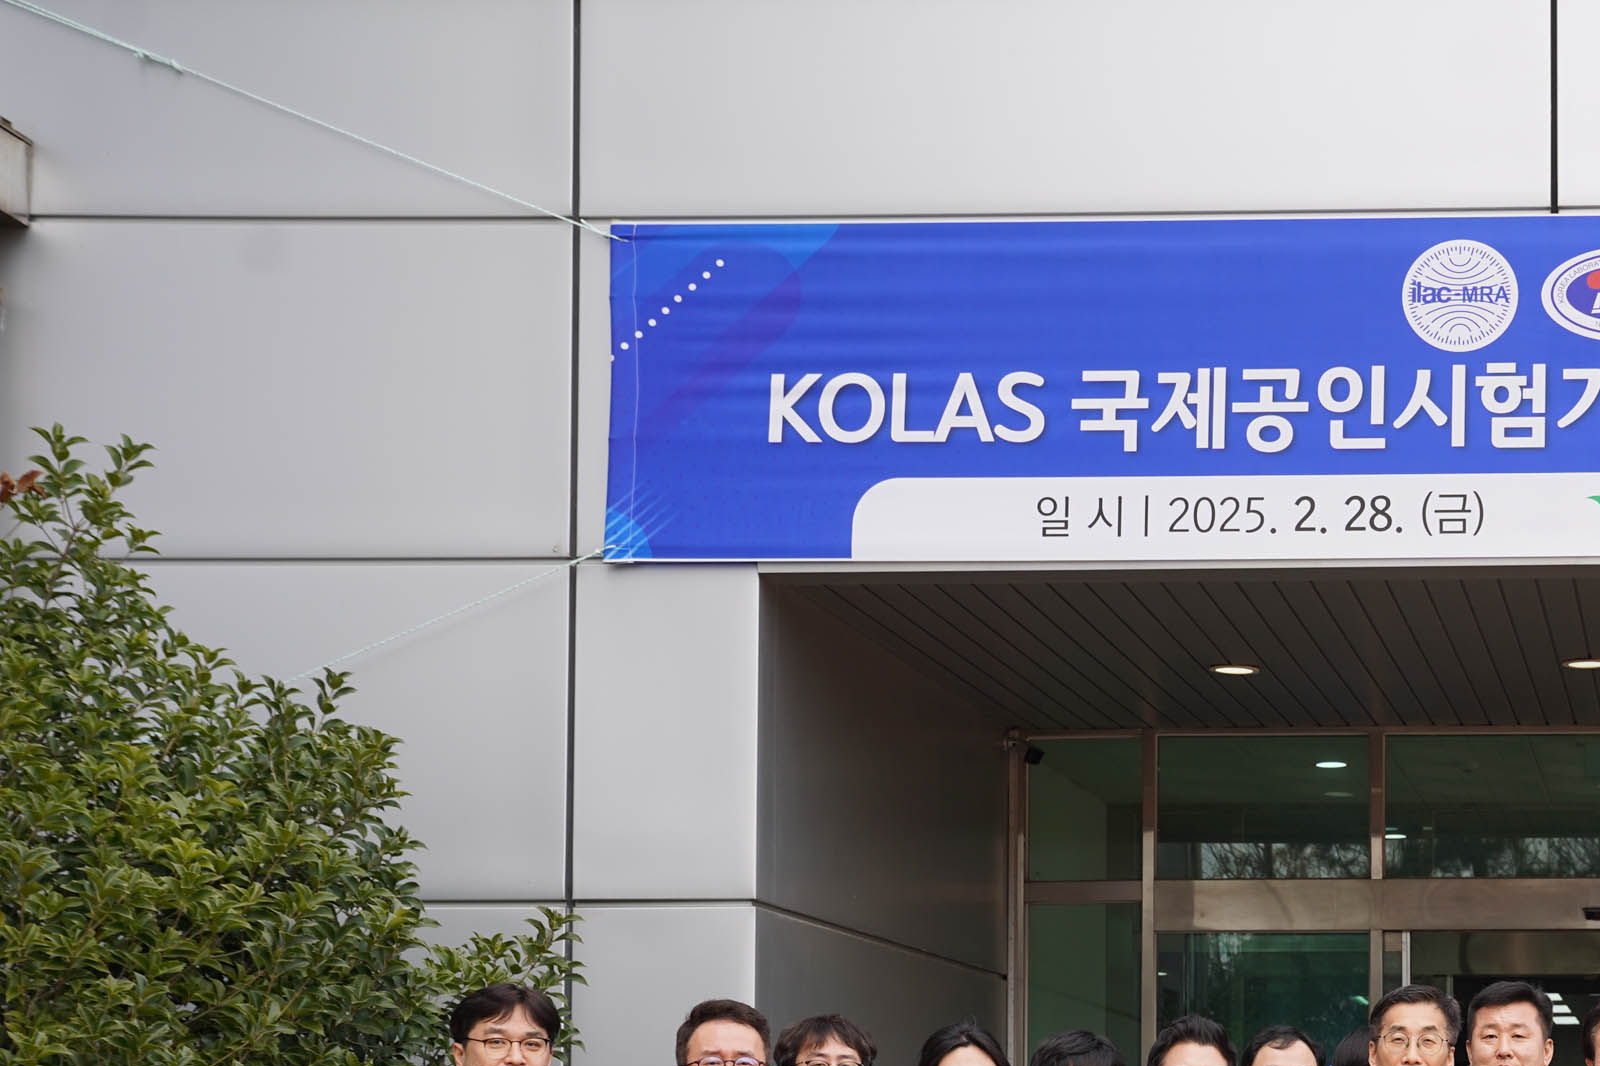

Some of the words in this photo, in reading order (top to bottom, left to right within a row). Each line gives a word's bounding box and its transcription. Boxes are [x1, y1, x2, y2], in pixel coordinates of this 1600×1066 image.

[1410, 281, 1509, 303] ilac-MRA
[768, 372, 1046, 444] KOLAS
[1036, 497, 1070, 537] 일
[1087, 496, 1124, 537] 시
[1168, 496, 1278, 535] 2025.
[1293, 496, 1329, 534] 2.
[1344, 495, 1403, 534] 28.
[1421, 489, 1484, 537] (금)
